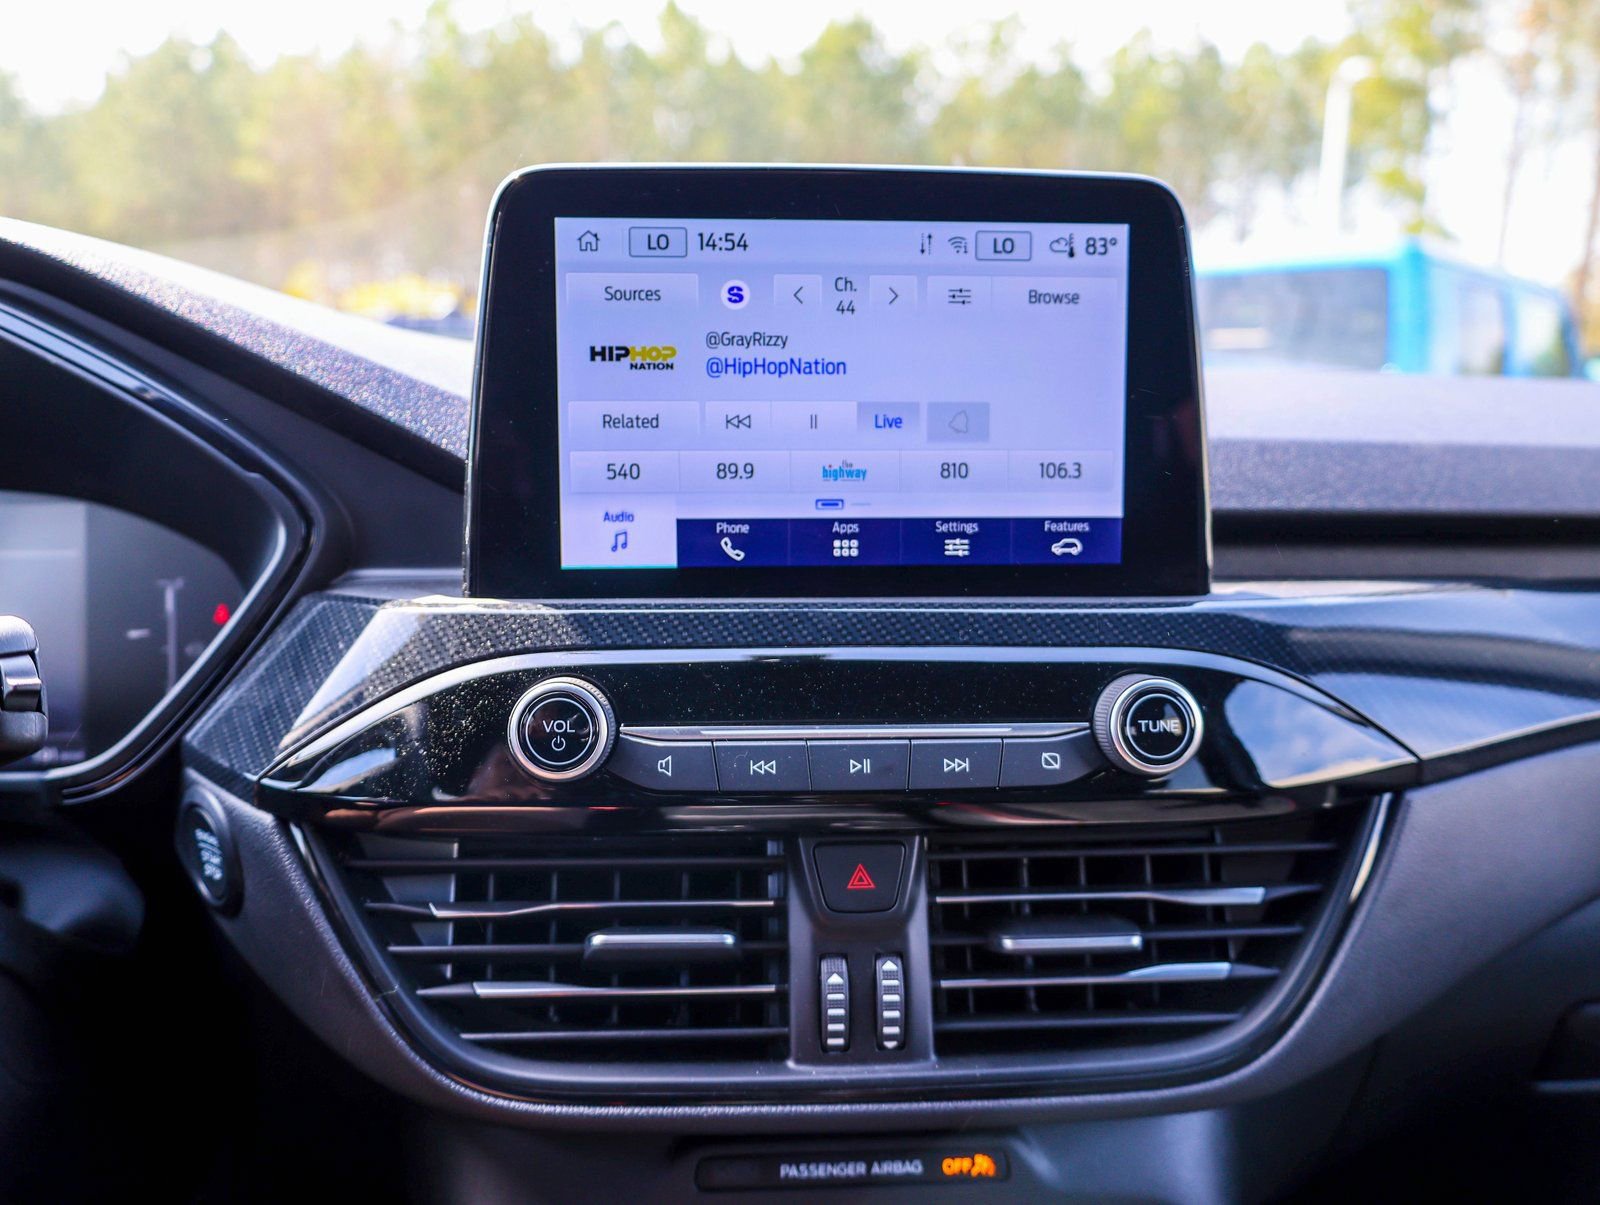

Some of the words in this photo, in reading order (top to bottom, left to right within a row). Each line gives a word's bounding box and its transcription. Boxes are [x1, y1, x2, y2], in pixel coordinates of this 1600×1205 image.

[647, 233, 670, 251] LO
[698, 232, 749, 252] 14:54
[993, 238, 1015, 254] LO
[1085, 237, 1117, 256] 83°
[834, 277, 857, 293] Ch.
[604, 286, 661, 302] Sources
[1029, 289, 1080, 305] Browse
[836, 300, 856, 315] 44
[706, 331, 788, 350] @GrayRizzy
[629, 362, 674, 370] NATION
[706, 357, 847, 378] @HipHopNation
[602, 414, 660, 430] Related
[874, 414, 903, 430] Live
[606, 463, 640, 480] 540
[716, 462, 755, 480] 89.9
[822, 464, 867, 481] highway
[940, 462, 969, 479] 810
[1039, 462, 1082, 479] 106.3
[603, 511, 635, 523] Audio
[716, 522, 750, 534] Phone
[832, 521, 860, 536] Apps
[935, 521, 979, 535] Settings
[1044, 520, 1090, 533] Features
[542, 720, 576, 733] VOL
[1138, 719, 1180, 733] TUNE
[780, 1162, 867, 1179] PASSENGER
[871, 1159, 924, 1176] AIRBAG
[941, 1158, 972, 1176] OFF
